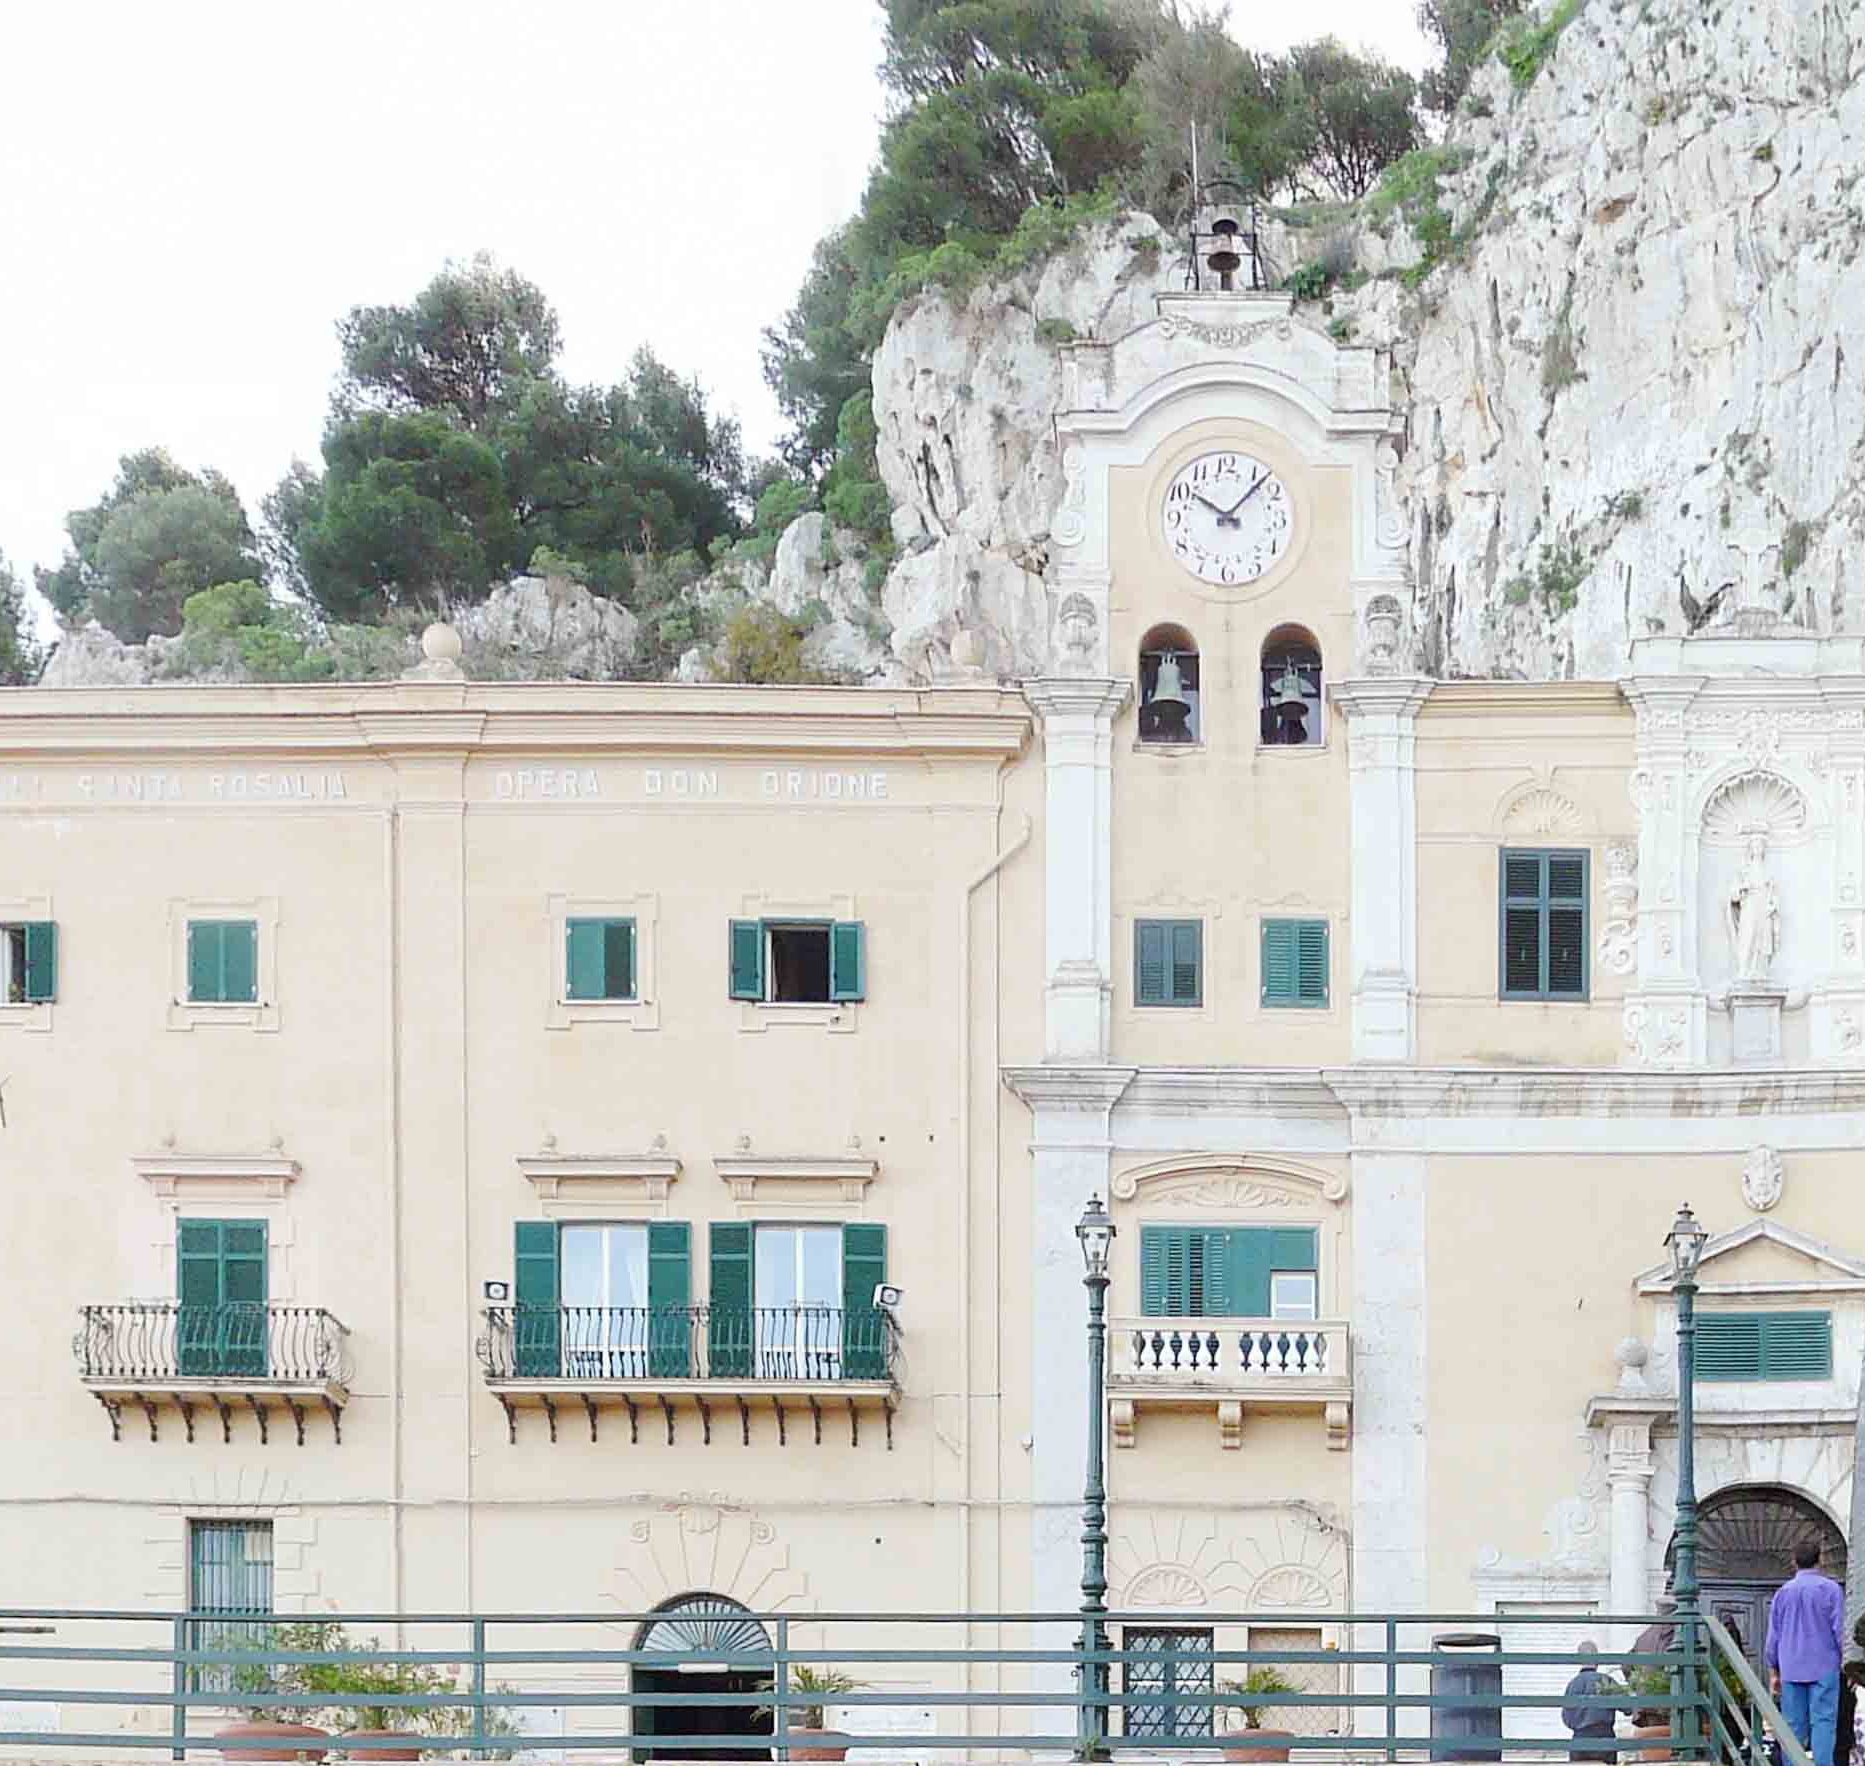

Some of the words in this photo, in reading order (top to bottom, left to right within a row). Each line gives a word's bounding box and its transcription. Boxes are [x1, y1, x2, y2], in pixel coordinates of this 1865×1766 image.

[495, 768, 601, 800] OPERA
[645, 769, 720, 798] DON
[758, 769, 888, 799] ORIONE
